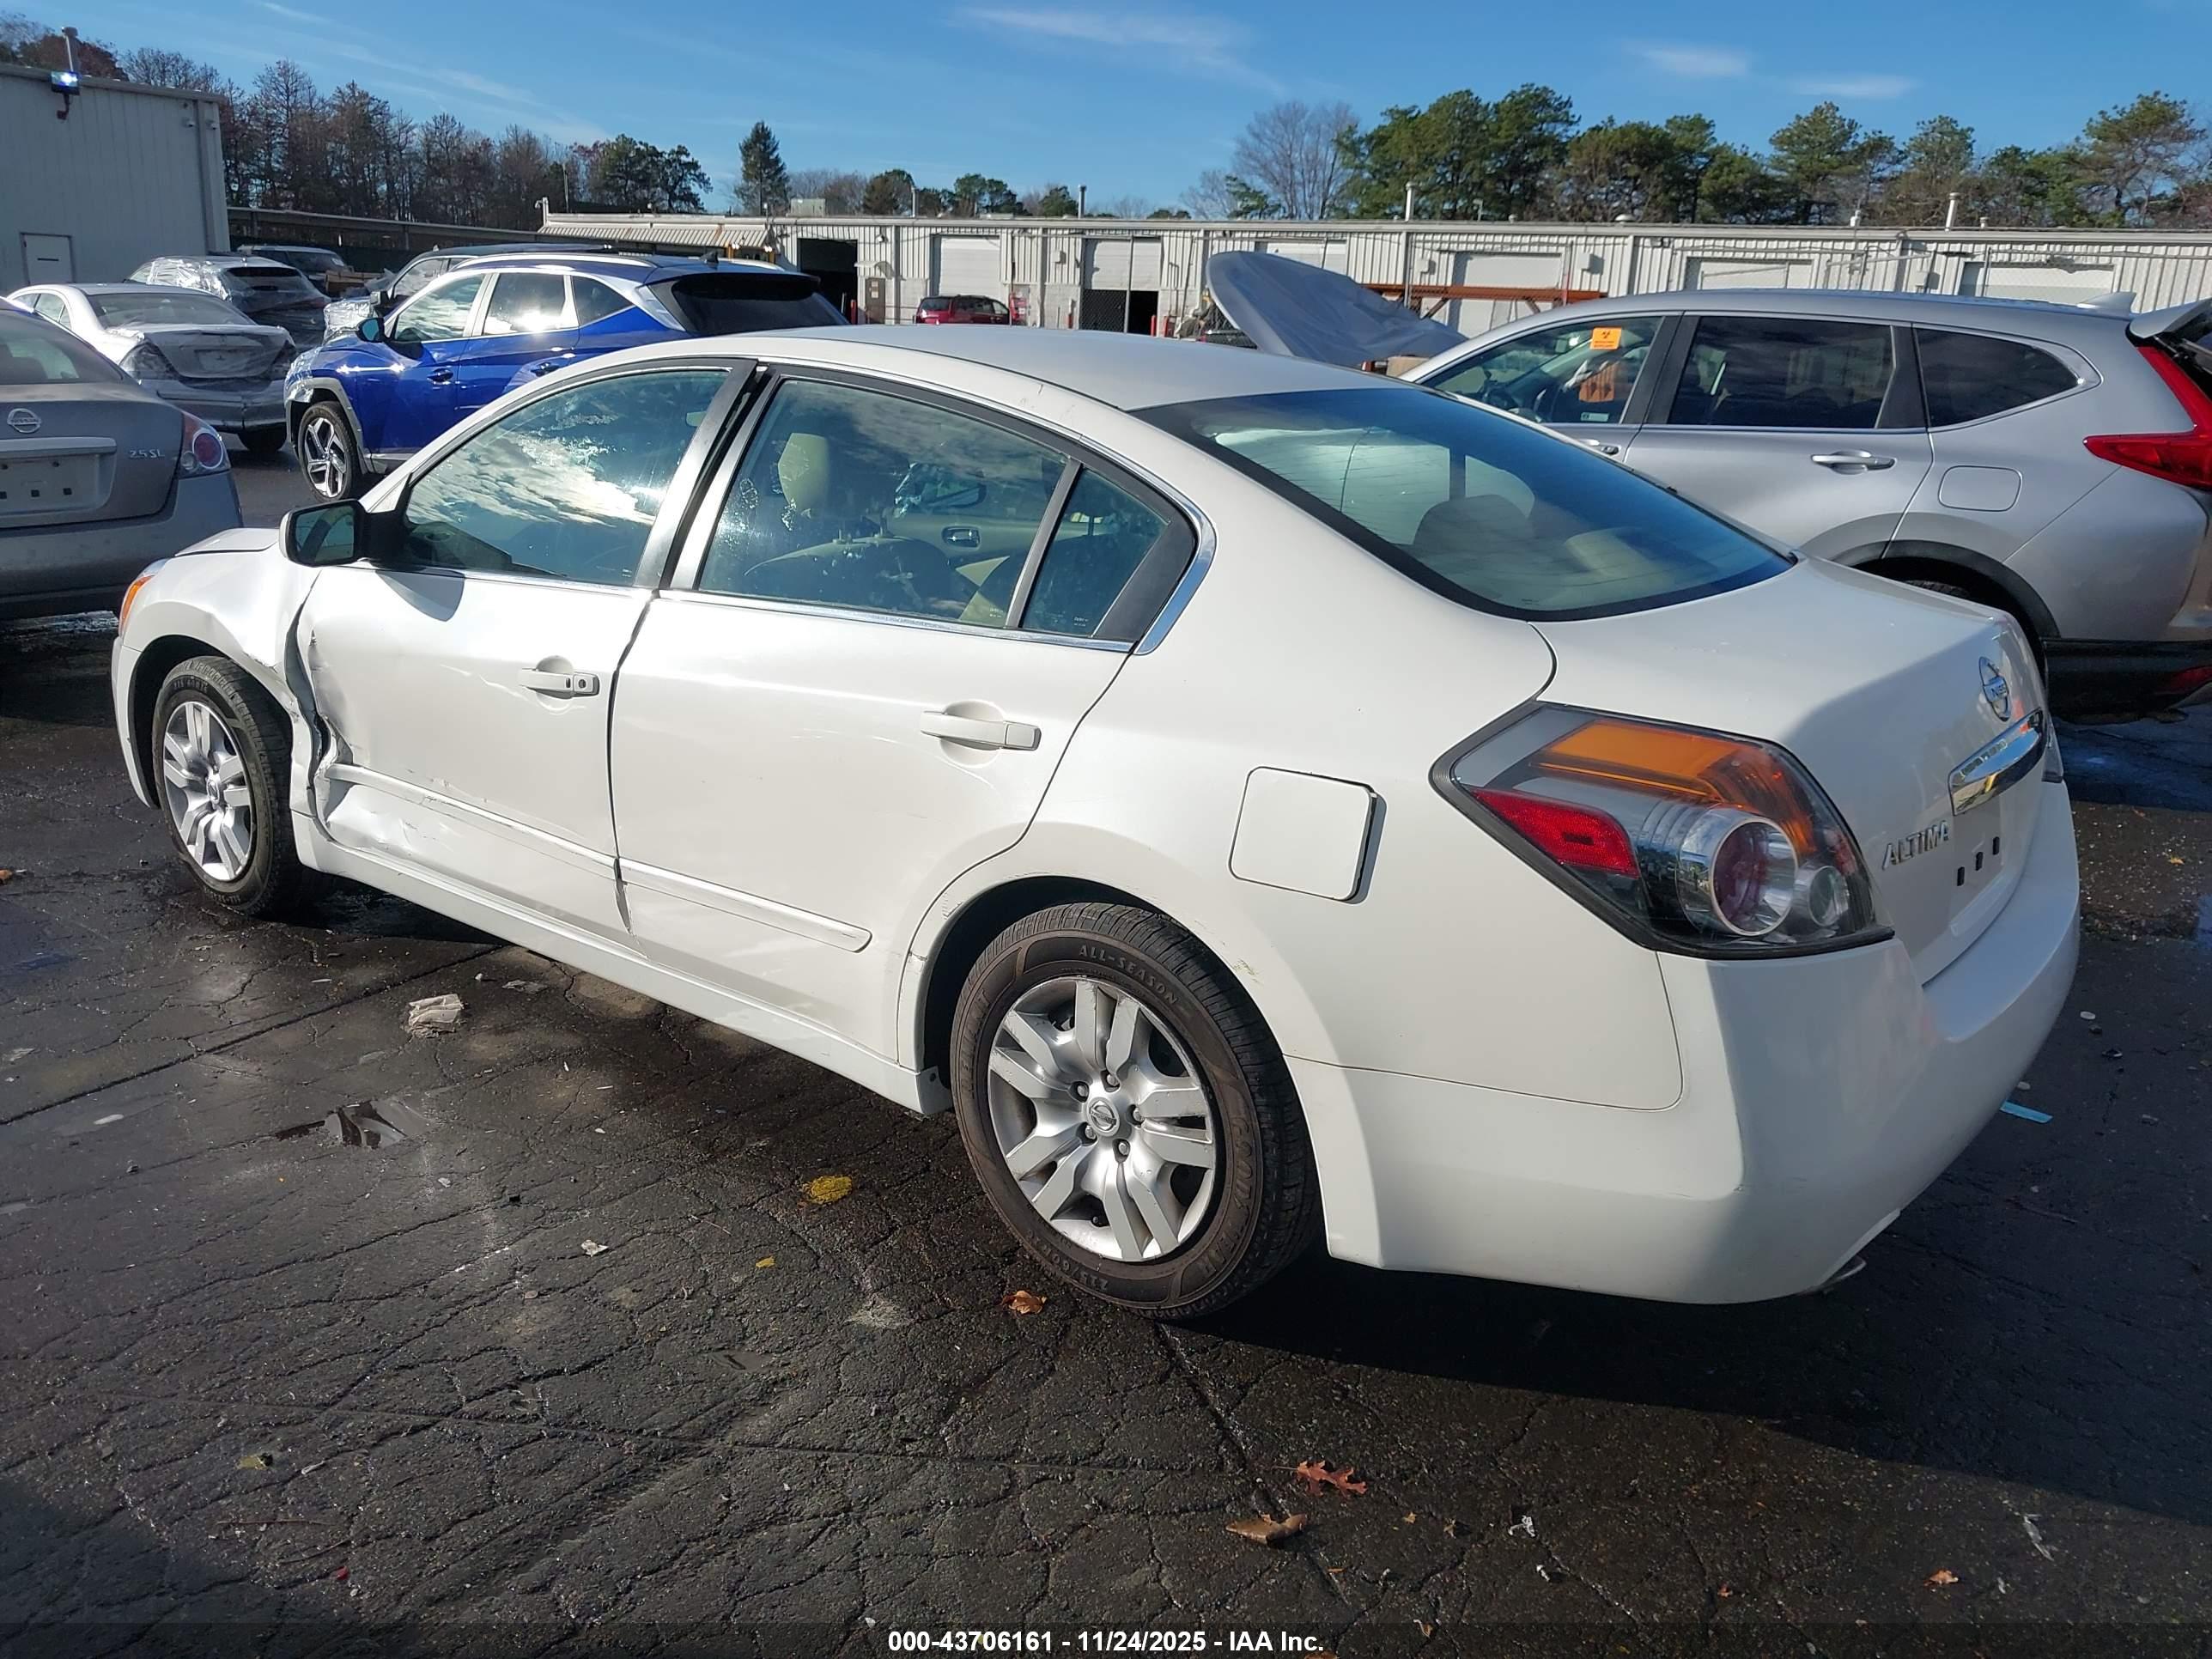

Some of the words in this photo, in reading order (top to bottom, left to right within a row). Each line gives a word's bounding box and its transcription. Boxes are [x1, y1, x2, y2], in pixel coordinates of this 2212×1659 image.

[149, 448, 166, 458] SL
[1881, 819, 1949, 871] ALTIMA
[1076, 944, 1179, 1005] ALL-SEASON
